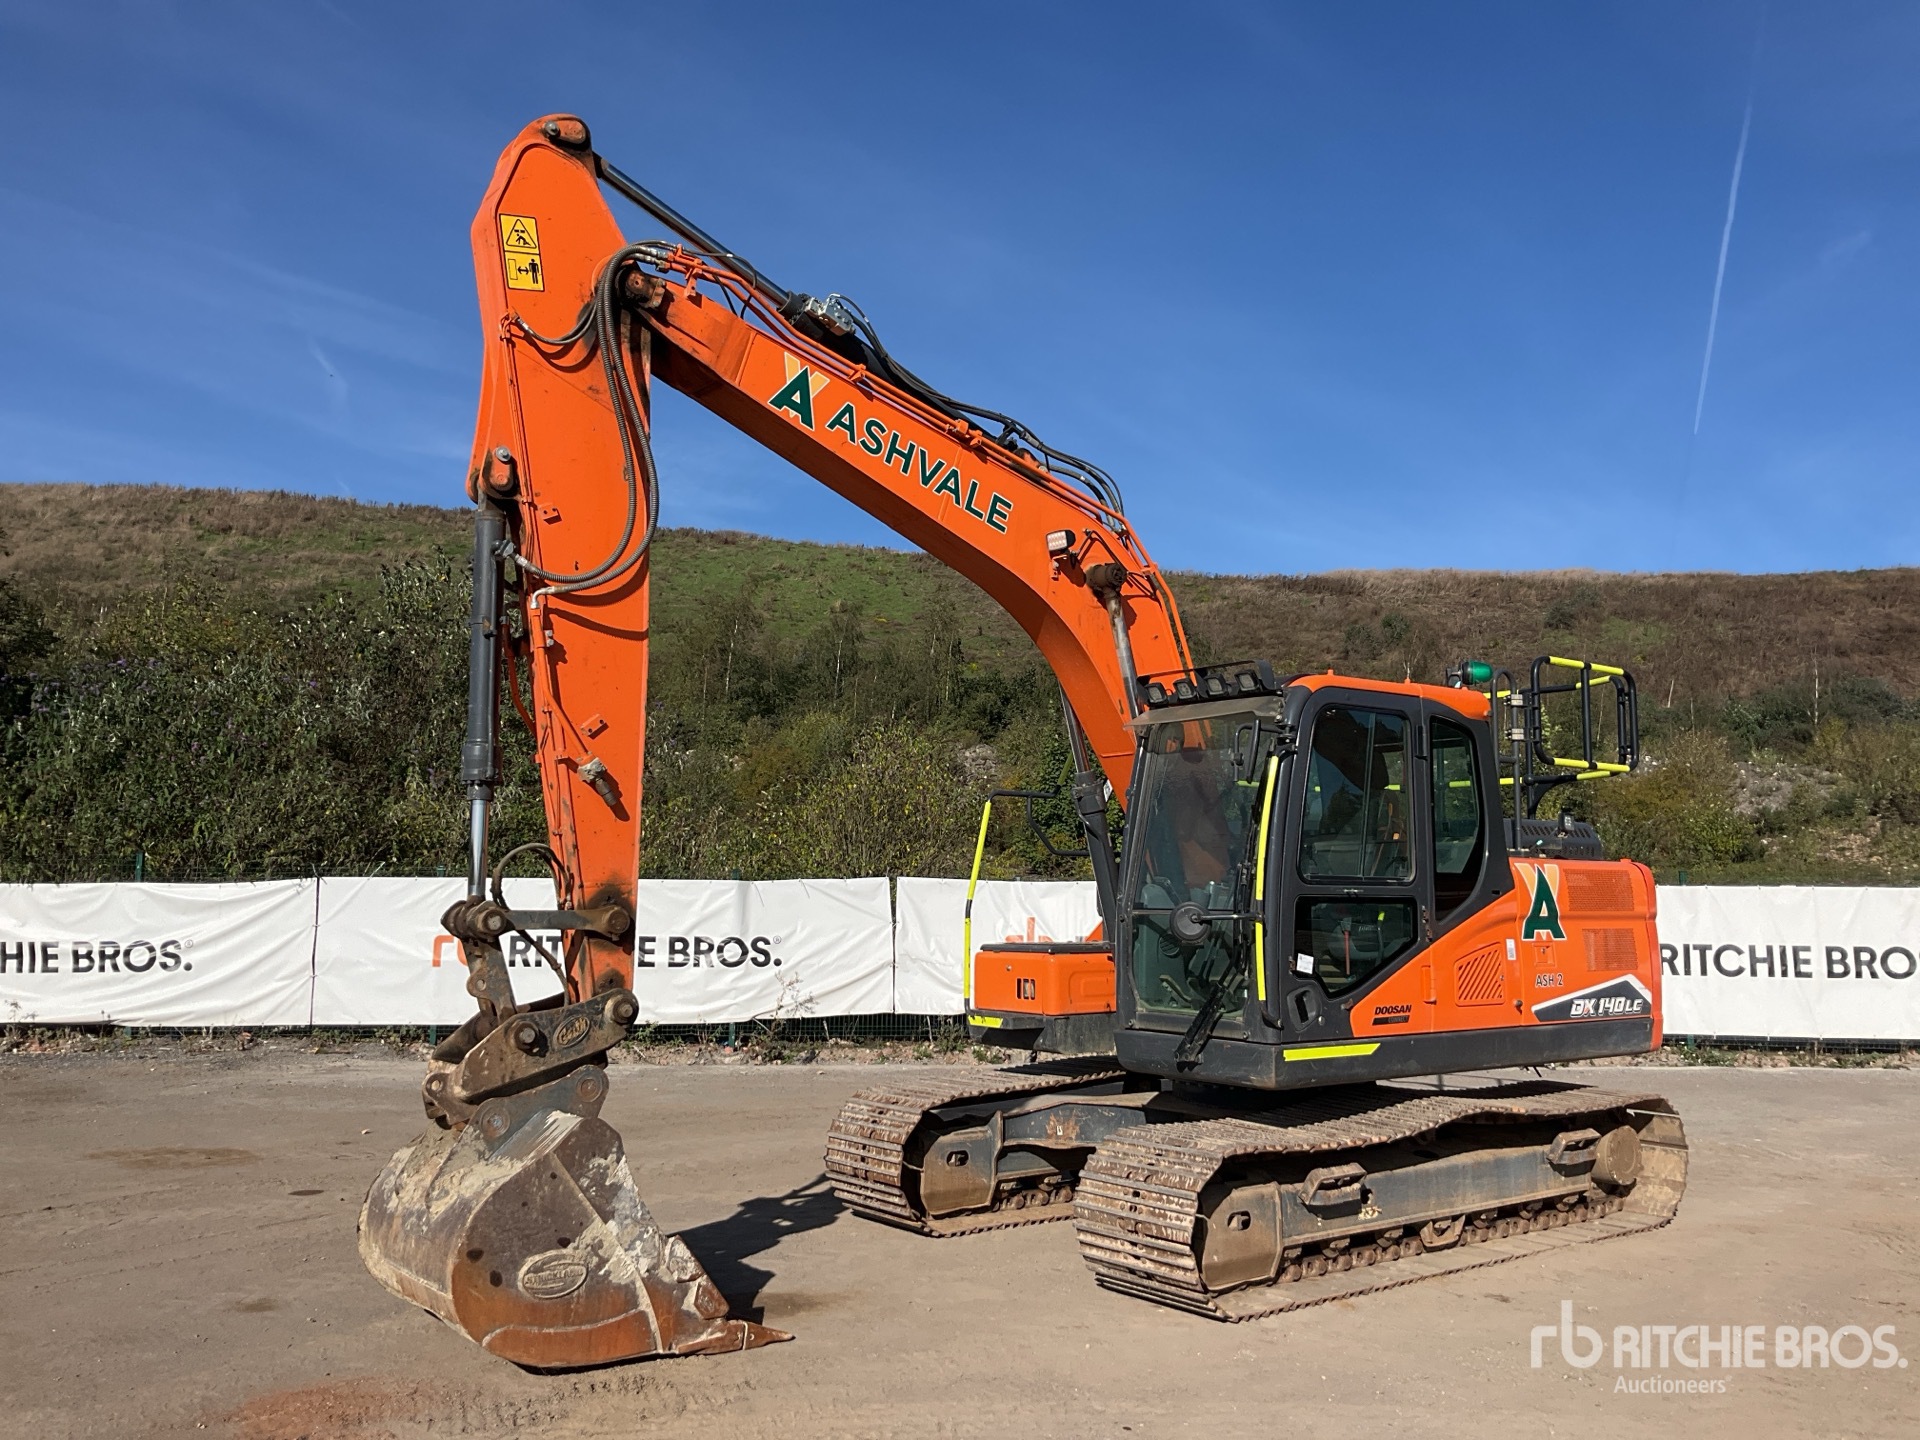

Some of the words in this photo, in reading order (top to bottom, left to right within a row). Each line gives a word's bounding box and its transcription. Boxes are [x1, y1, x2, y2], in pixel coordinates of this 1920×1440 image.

[825, 402, 1013, 533] ASHVALE
[1659, 943, 1813, 978] RITCHIE
[1825, 945, 1920, 979] BRO
[1535, 973, 1555, 986] ASH
[1557, 973, 1563, 986] 2
[1374, 1004, 1412, 1015] DOOSAN
